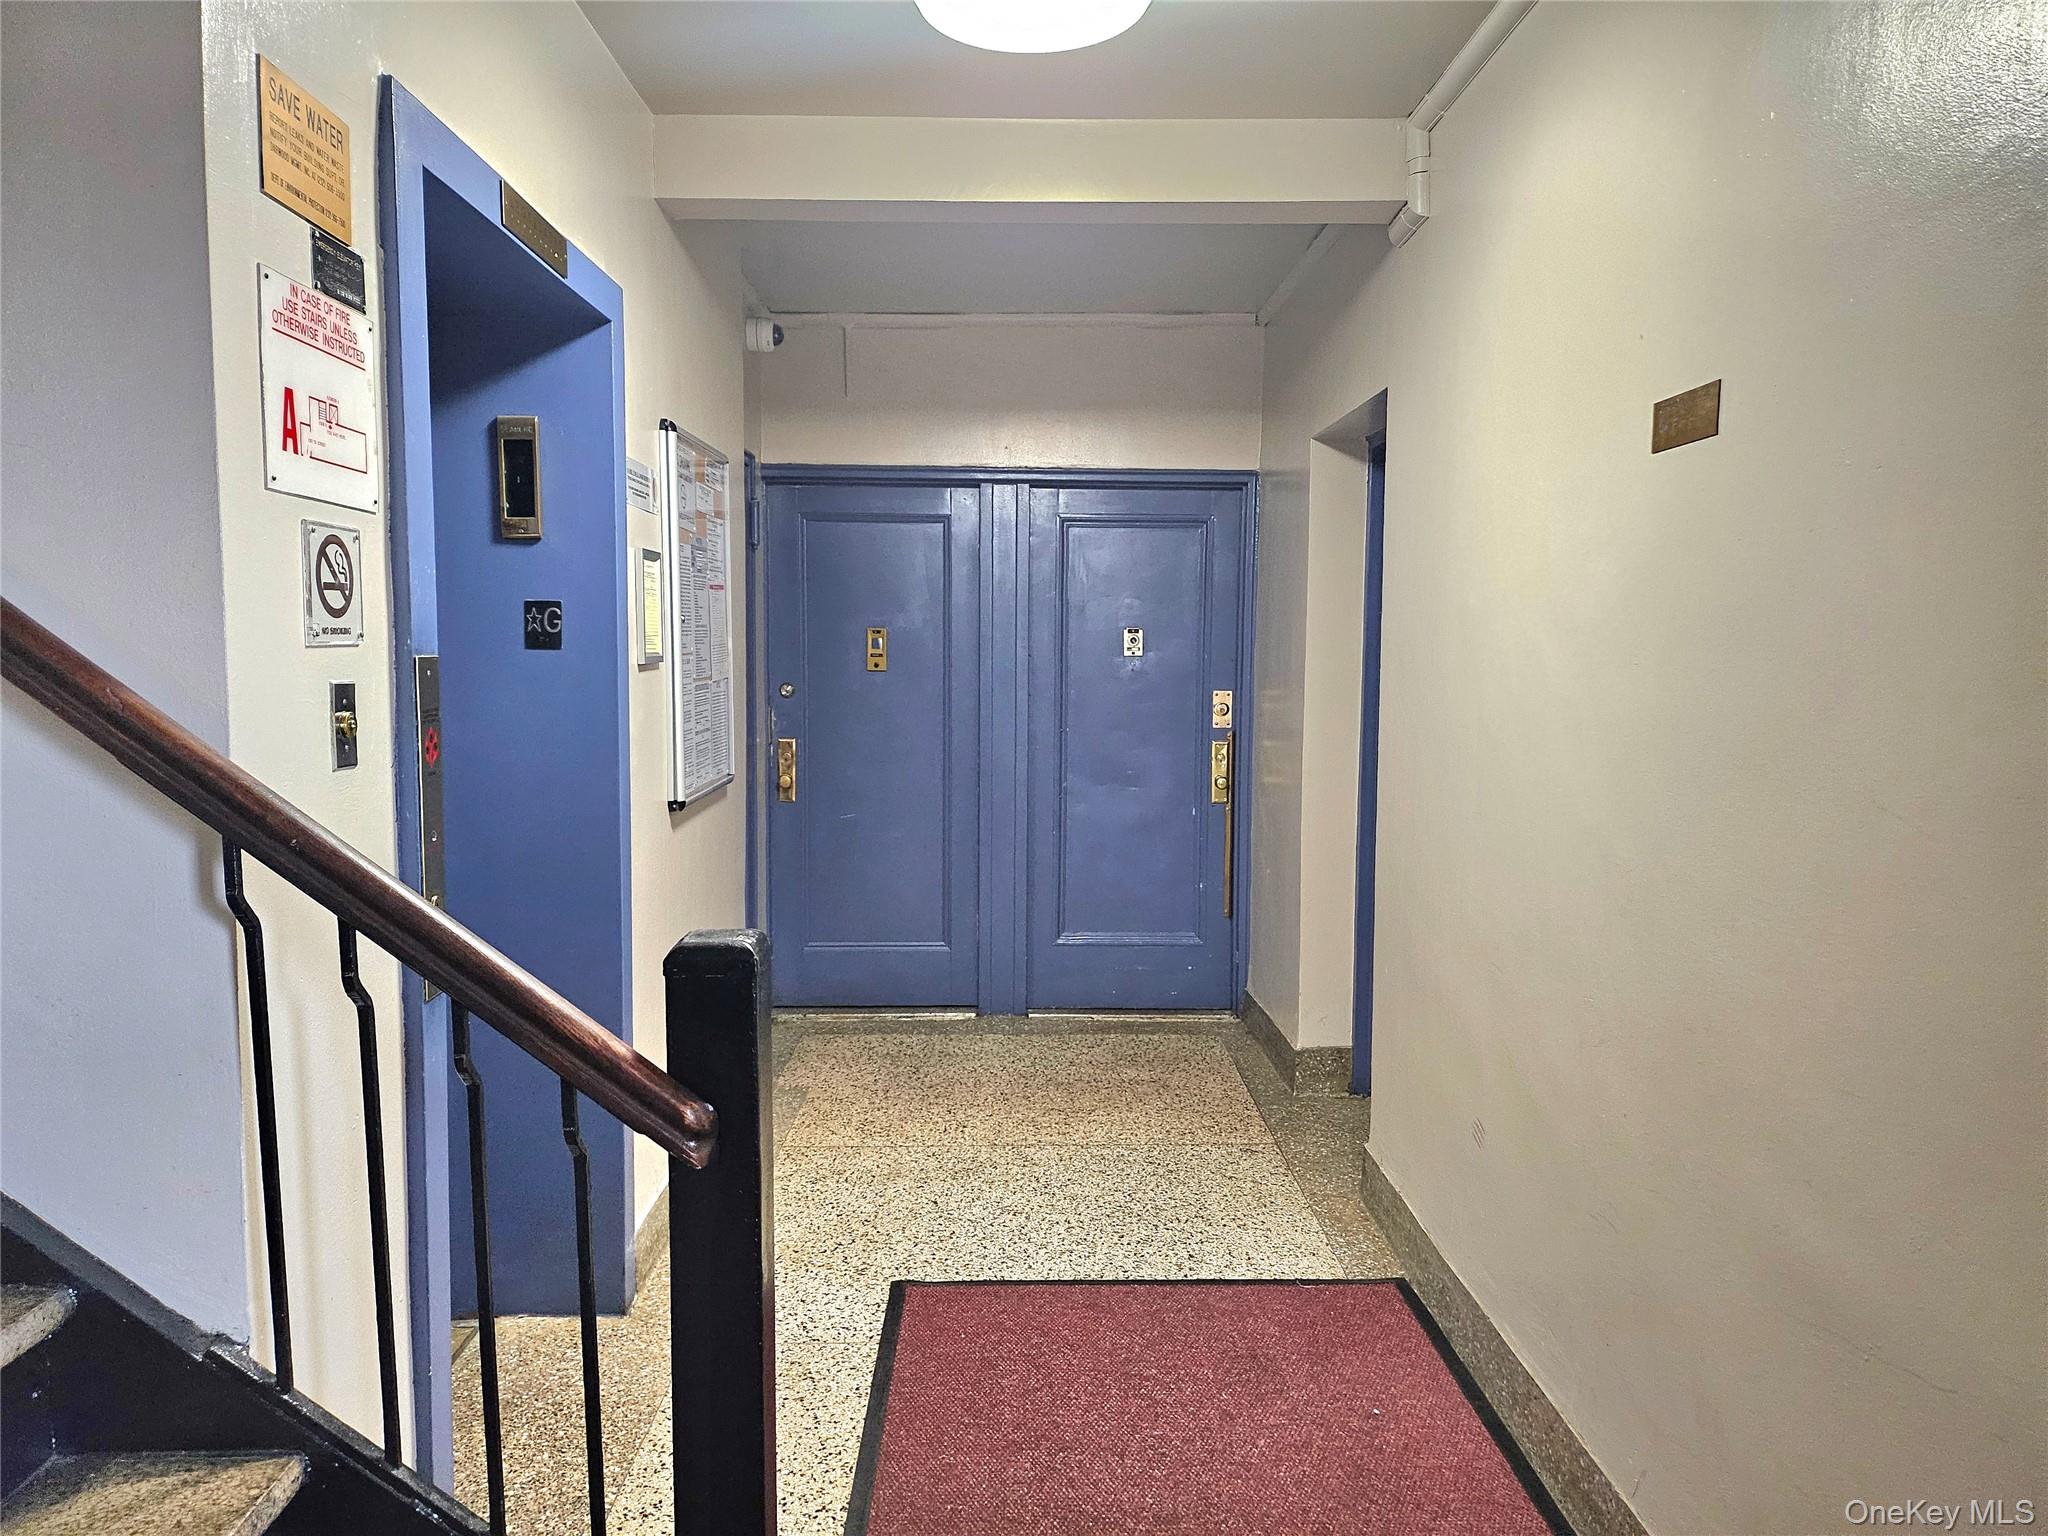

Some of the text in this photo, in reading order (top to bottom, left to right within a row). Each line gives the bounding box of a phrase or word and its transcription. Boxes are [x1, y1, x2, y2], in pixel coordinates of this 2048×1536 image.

[268, 77, 343, 153] SAVE WATER
[269, 127, 286, 145] NOTIFY
[289, 142, 301, 156] YOUR
[303, 152, 324, 172] BUILDING
[289, 127, 303, 143] LEAKS
[305, 138, 314, 151] AND
[315, 147, 329, 162] WATER
[331, 158, 344, 173] WASTE
[282, 296, 357, 345] USE STAIRS UNLESS
[289, 284, 350, 326] IN CASE OF FIRE
[271, 308, 364, 364] OTHERWISE INSTRUCTED
[282, 387, 299, 455] A
[322, 627, 351, 635] NO SMOKING
[544, 607, 562, 634] G
